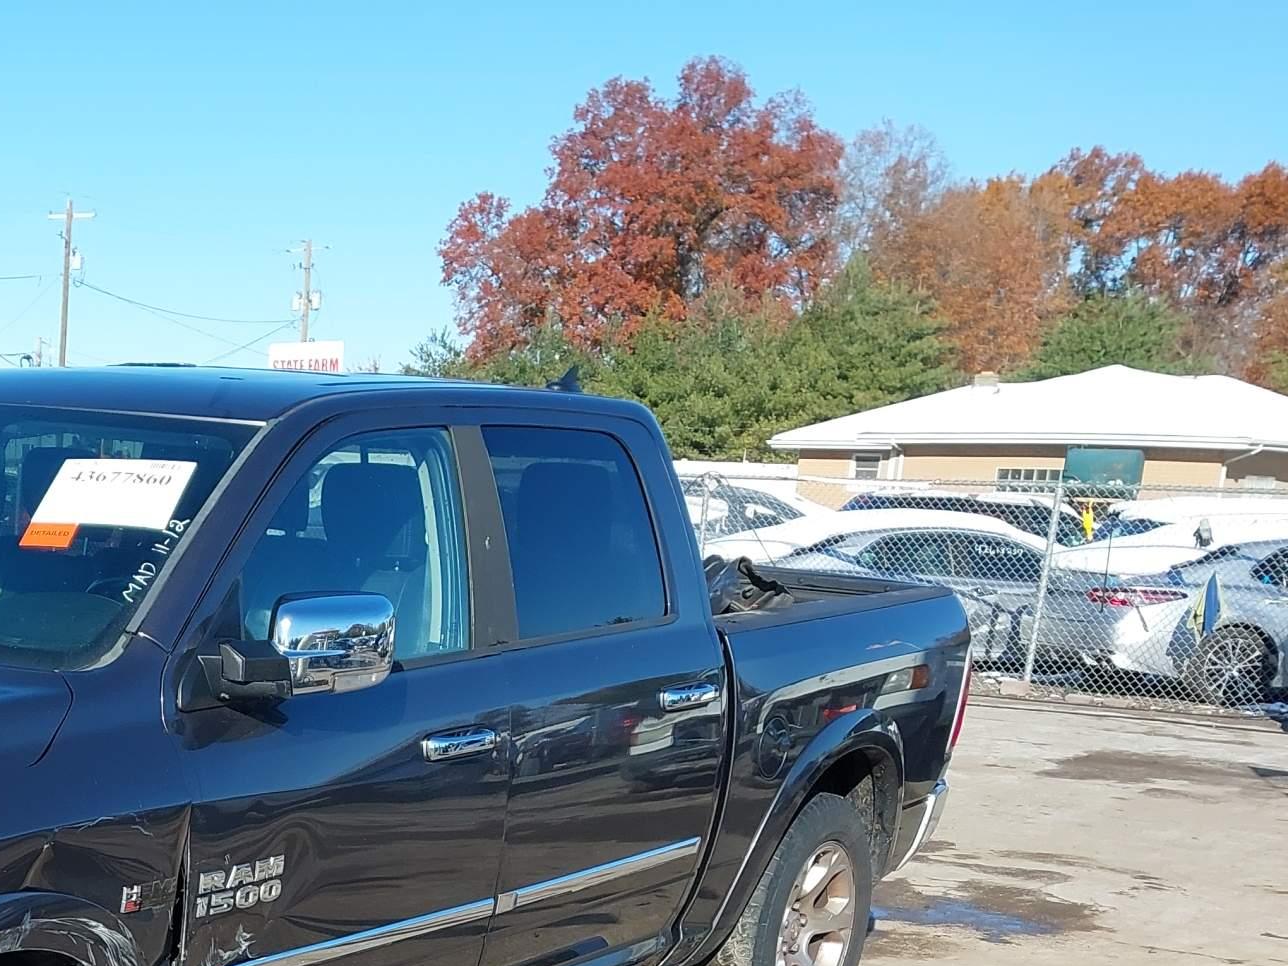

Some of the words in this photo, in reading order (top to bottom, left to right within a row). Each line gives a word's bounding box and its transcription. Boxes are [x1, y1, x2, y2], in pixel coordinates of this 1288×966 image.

[273, 359, 305, 371] STATE
[308, 358, 339, 373] FARM
[71, 470, 173, 486] 43677860
[29, 529, 70, 538] DETAILED
[122, 561, 156, 603] MAD
[198, 854, 285, 895] RAM
[195, 878, 282, 918] 1500
